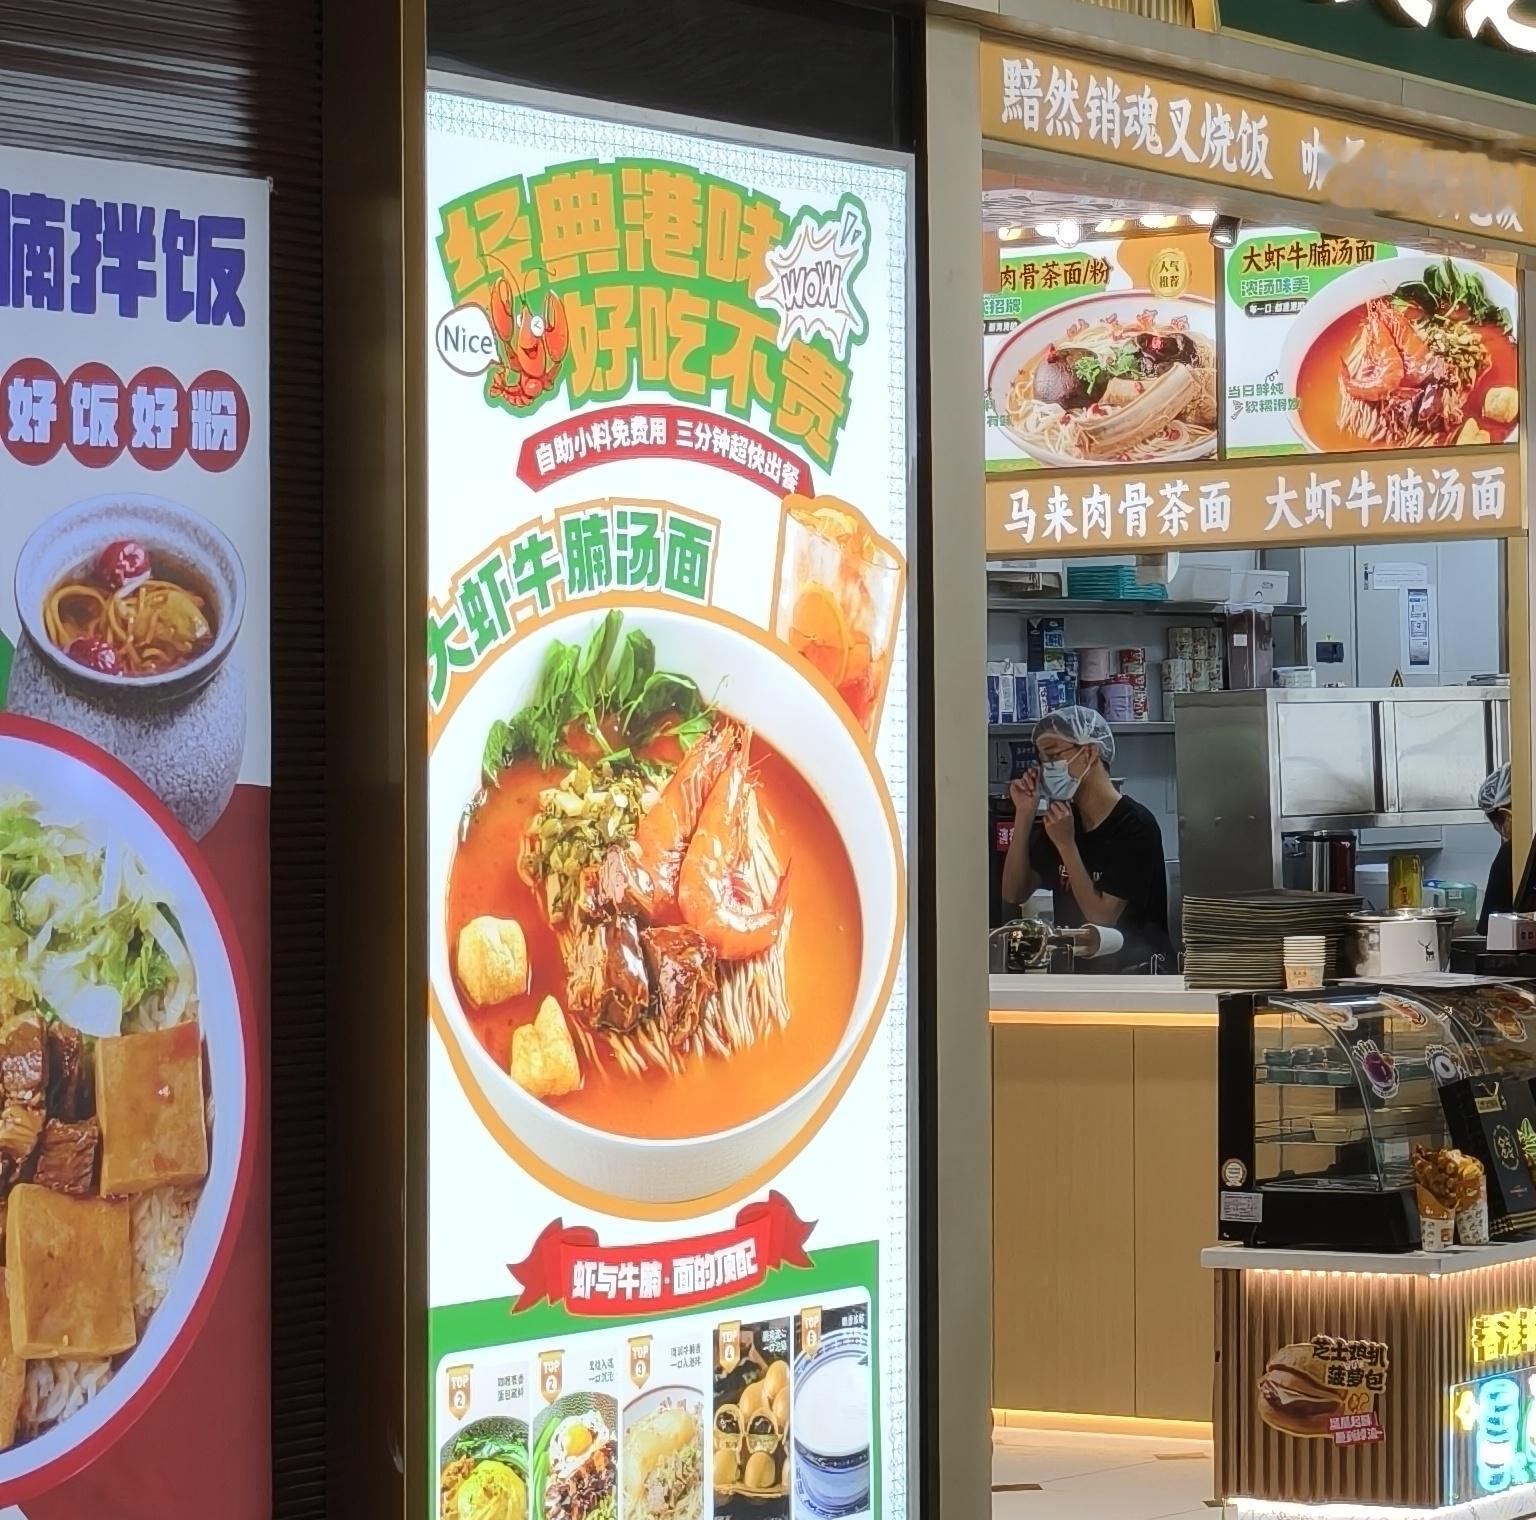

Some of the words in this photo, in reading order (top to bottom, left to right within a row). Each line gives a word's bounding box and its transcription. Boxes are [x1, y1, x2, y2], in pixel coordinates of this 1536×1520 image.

[1001, 58, 1273, 180] 黯然销魂叉烧饭
[444, 166, 785, 293] 经典港味
[0, 189, 246, 328] 腩拌饭
[1242, 238, 1376, 274] 大虾牛腩汤面
[780, 259, 842, 312] WOW
[443, 324, 494, 358] Nice
[566, 282, 852, 463] 好吃不贵
[8, 376, 237, 452] 好饭好粉
[535, 415, 667, 476] 自助小料免费用
[675, 419, 801, 493] 三分钟超快出餐
[1004, 479, 1233, 543] 马来肉骨茶面
[1263, 466, 1507, 533] 大虾牛腩汤面
[427, 511, 713, 698] 大虾牛腩汤面
[722, 1330, 738, 1344] TOP
[803, 1316, 819, 1329] TOP
[543, 1359, 560, 1375] TOP
[631, 1344, 648, 1359] TOP
[451, 1374, 469, 1390] TOP
[547, 1378, 556, 1391] 2
[636, 1363, 646, 1377] 3
[1327, 1364, 1384, 1391] 菠萝包
[456, 1393, 464, 1408] 2
